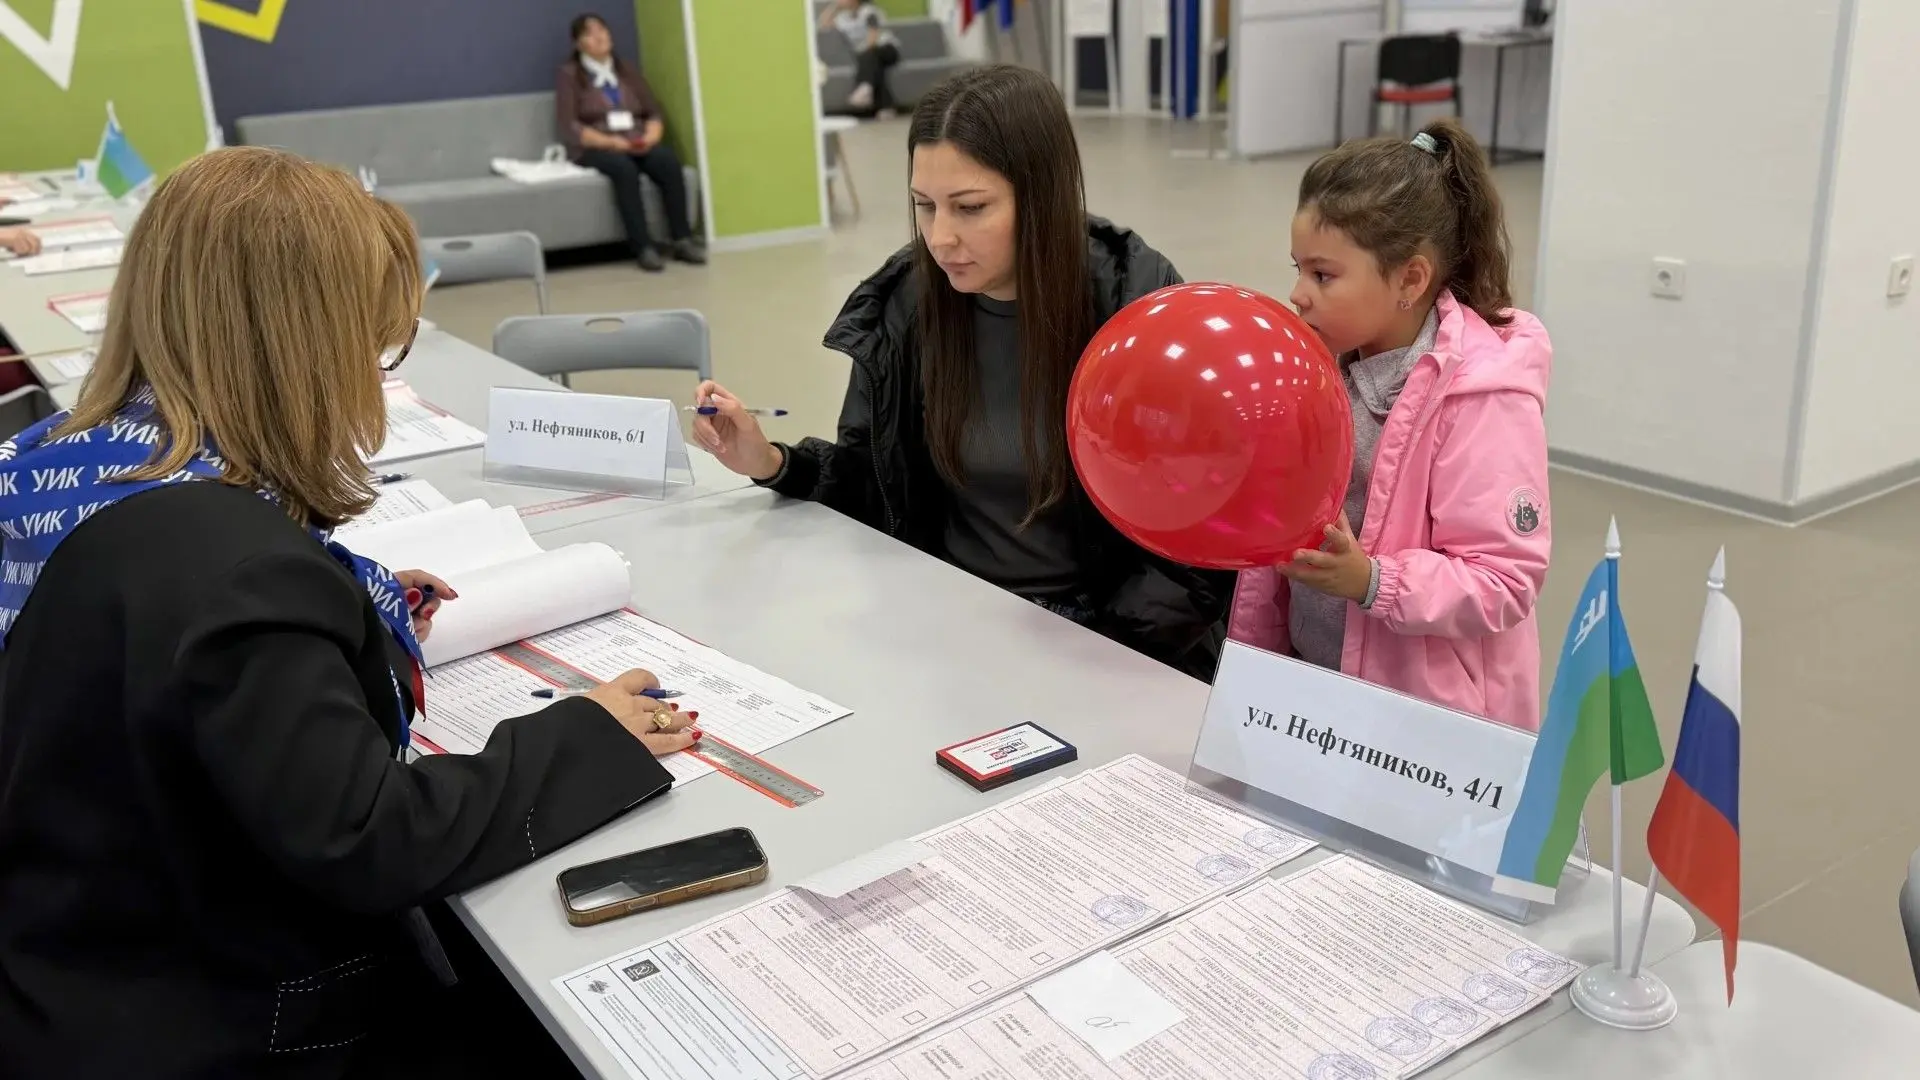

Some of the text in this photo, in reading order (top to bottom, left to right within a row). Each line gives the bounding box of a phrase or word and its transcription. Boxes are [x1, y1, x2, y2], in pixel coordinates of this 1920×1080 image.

[508, 419, 645, 444] ул. Нефтяников, 6/1
[31, 466, 85, 493] УИК
[22, 508, 68, 538] УИК
[1244, 705, 1504, 810] ул. Нефтяников, 4/1
